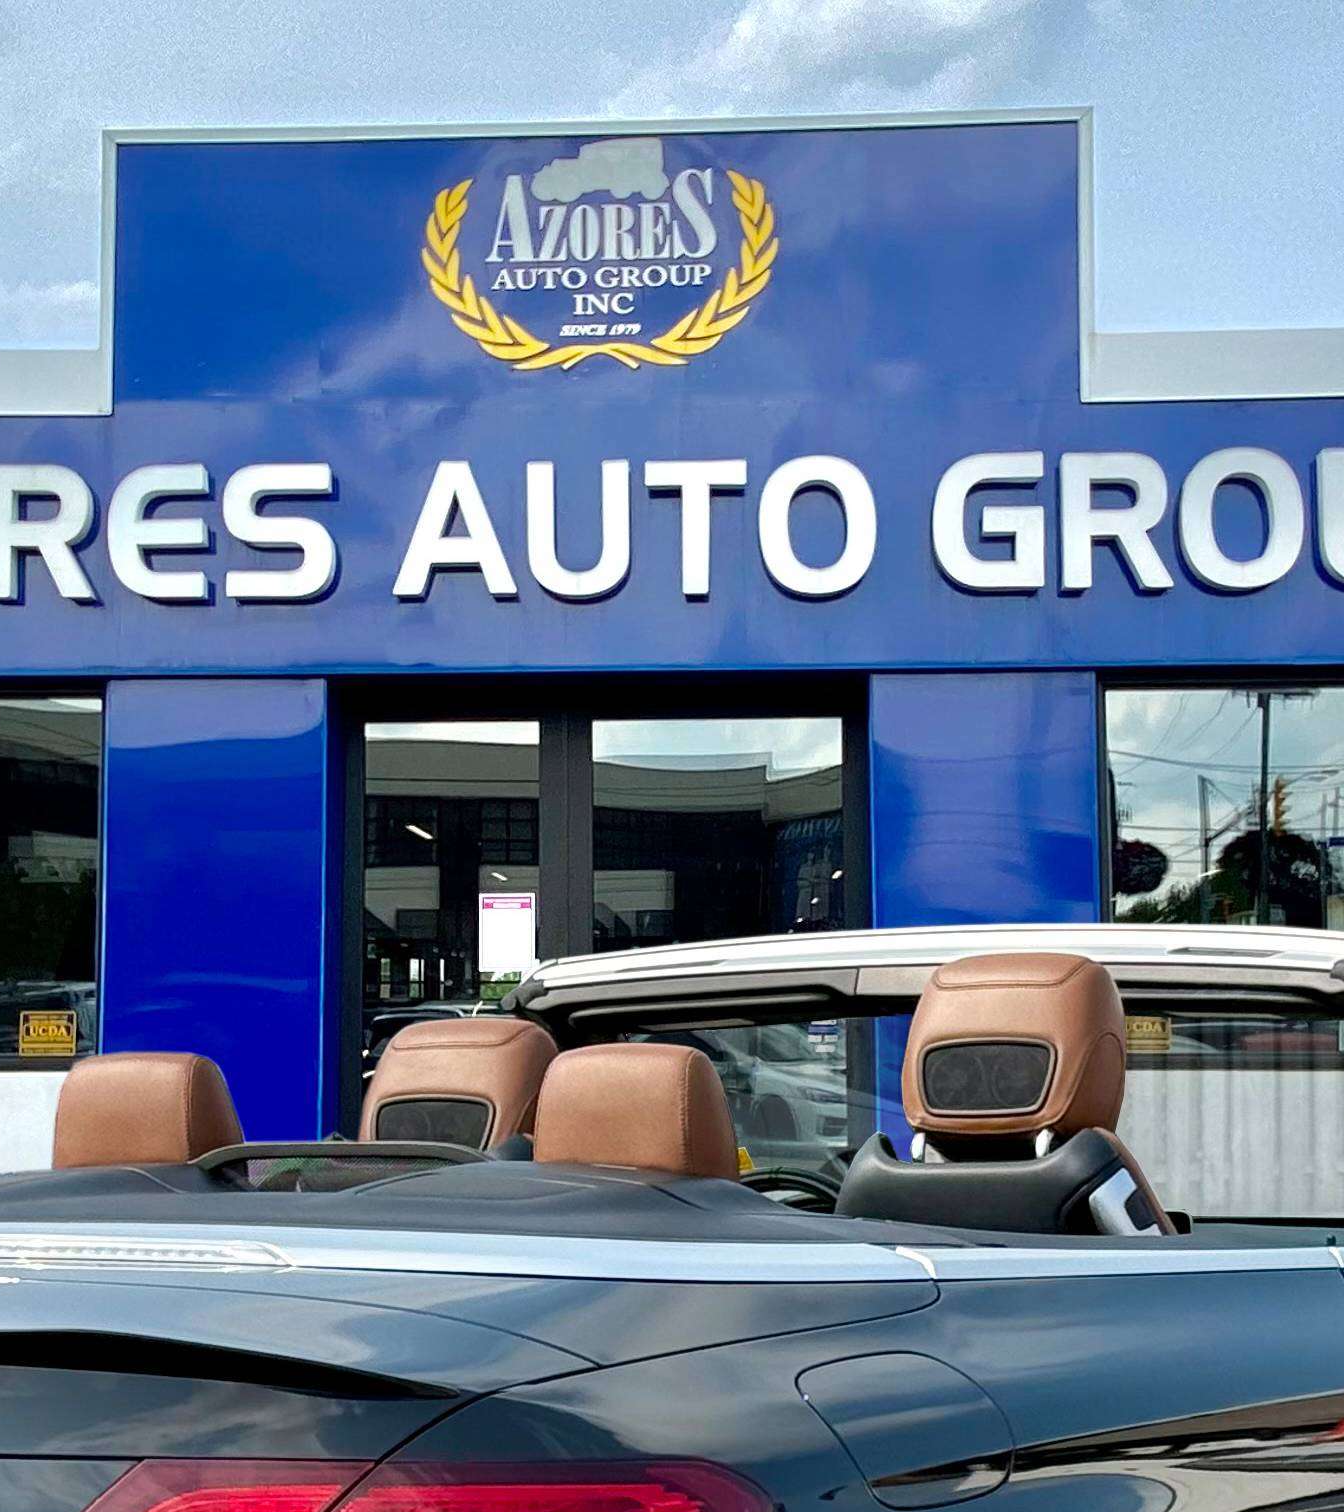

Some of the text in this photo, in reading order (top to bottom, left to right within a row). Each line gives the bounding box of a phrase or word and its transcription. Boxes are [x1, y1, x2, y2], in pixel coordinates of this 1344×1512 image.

[485, 168, 717, 262] AZORES
[492, 264, 712, 290] AUTO GROUP
[573, 293, 635, 316] INC
[559, 323, 642, 337] SINCE 1979
[392, 456, 878, 601] AUTO
[29, 1024, 68, 1038] UCDA
